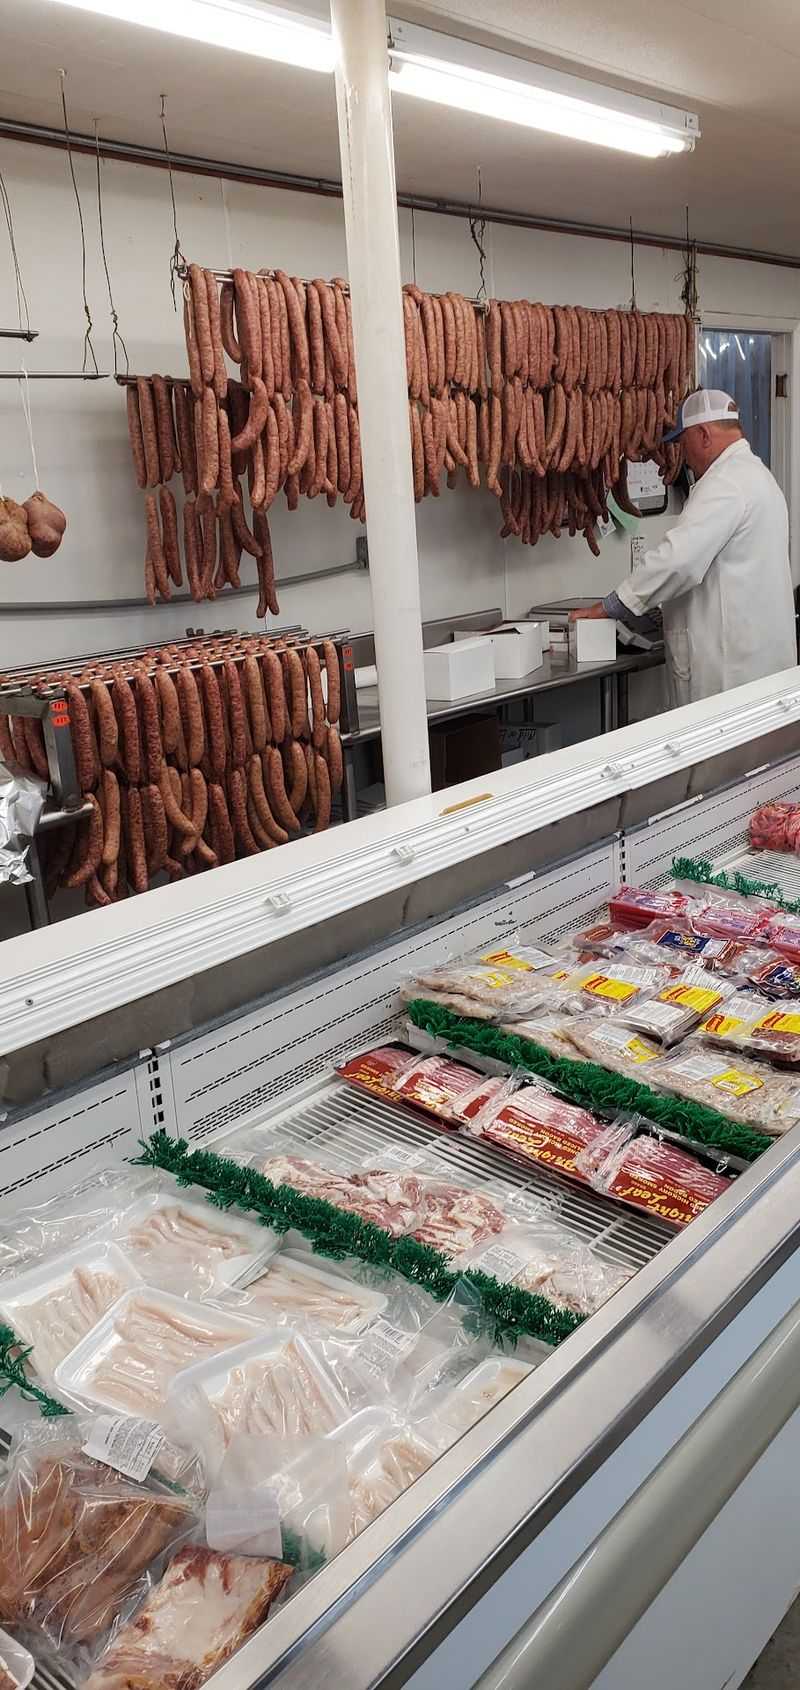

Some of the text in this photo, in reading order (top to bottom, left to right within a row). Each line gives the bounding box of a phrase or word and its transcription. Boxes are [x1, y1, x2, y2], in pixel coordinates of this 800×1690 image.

[619, 1186, 668, 1208] Leaf
[658, 1186, 689, 1205] HICKORY
[646, 1202, 695, 1224] right
